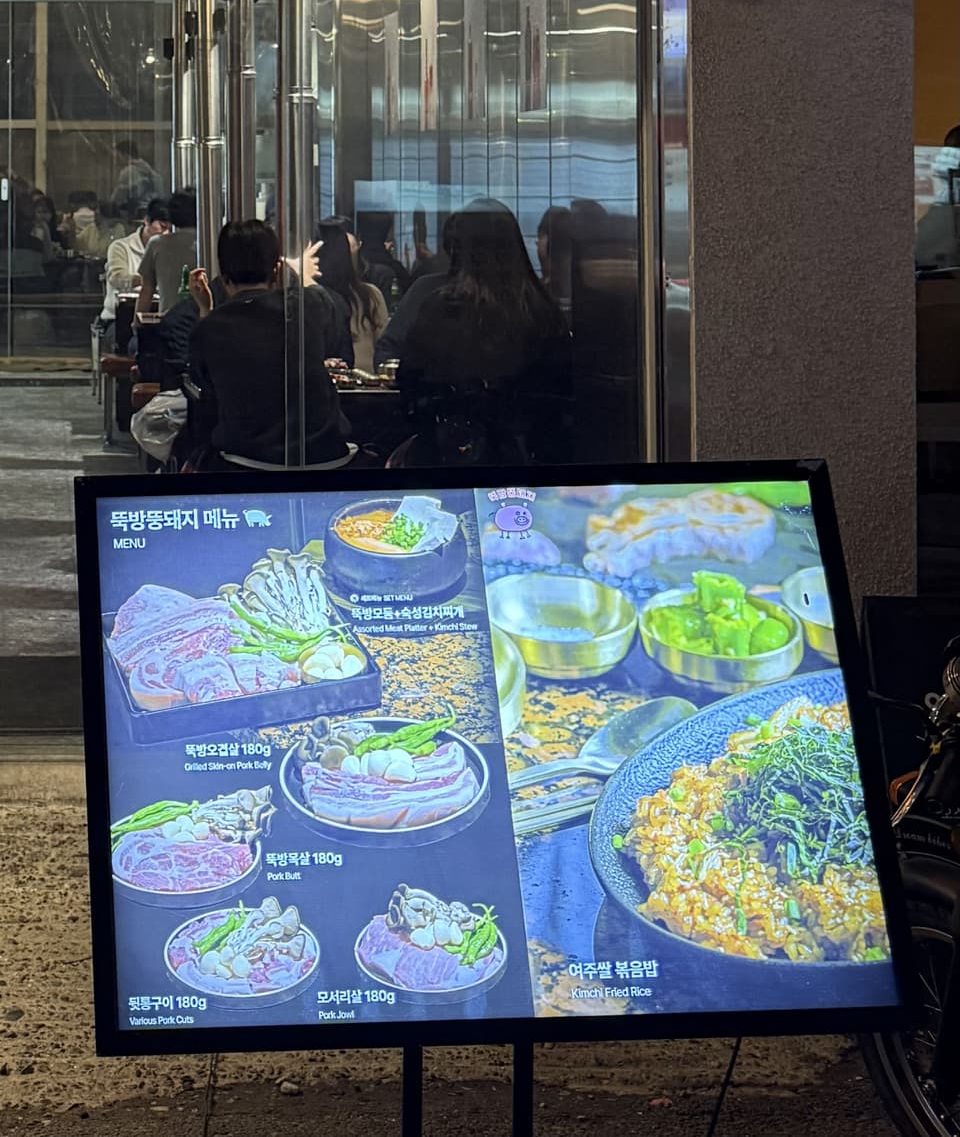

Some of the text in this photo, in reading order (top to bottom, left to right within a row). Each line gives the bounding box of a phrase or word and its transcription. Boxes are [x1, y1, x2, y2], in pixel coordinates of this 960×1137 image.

[110, 508, 240, 532] 뚝방뚱돼지 메뉴
[113, 537, 146, 550] MENU
[352, 625, 385, 634] Assorted
[385, 625, 404, 633] Meat
[435, 623, 459, 632] Kimchi
[459, 623, 478, 631] Stew
[185, 742, 272, 758] 뚝방오겹살 180g
[236, 761, 254, 770] Pork
[254, 760, 272, 771] Belly
[265, 851, 343, 867] 뚝방목살 180g
[267, 871, 302, 881] Pork Butt
[568, 959, 660, 980] 여주쌀 볶음밥
[317, 989, 396, 1005] 모서리살 180g
[571, 986, 653, 999] Kimchi Fried Rice
[175, 996, 207, 1011] 180g
[129, 1015, 195, 1025] Various Pork Cuts
[319, 1010, 355, 1020] Pork Jowl
